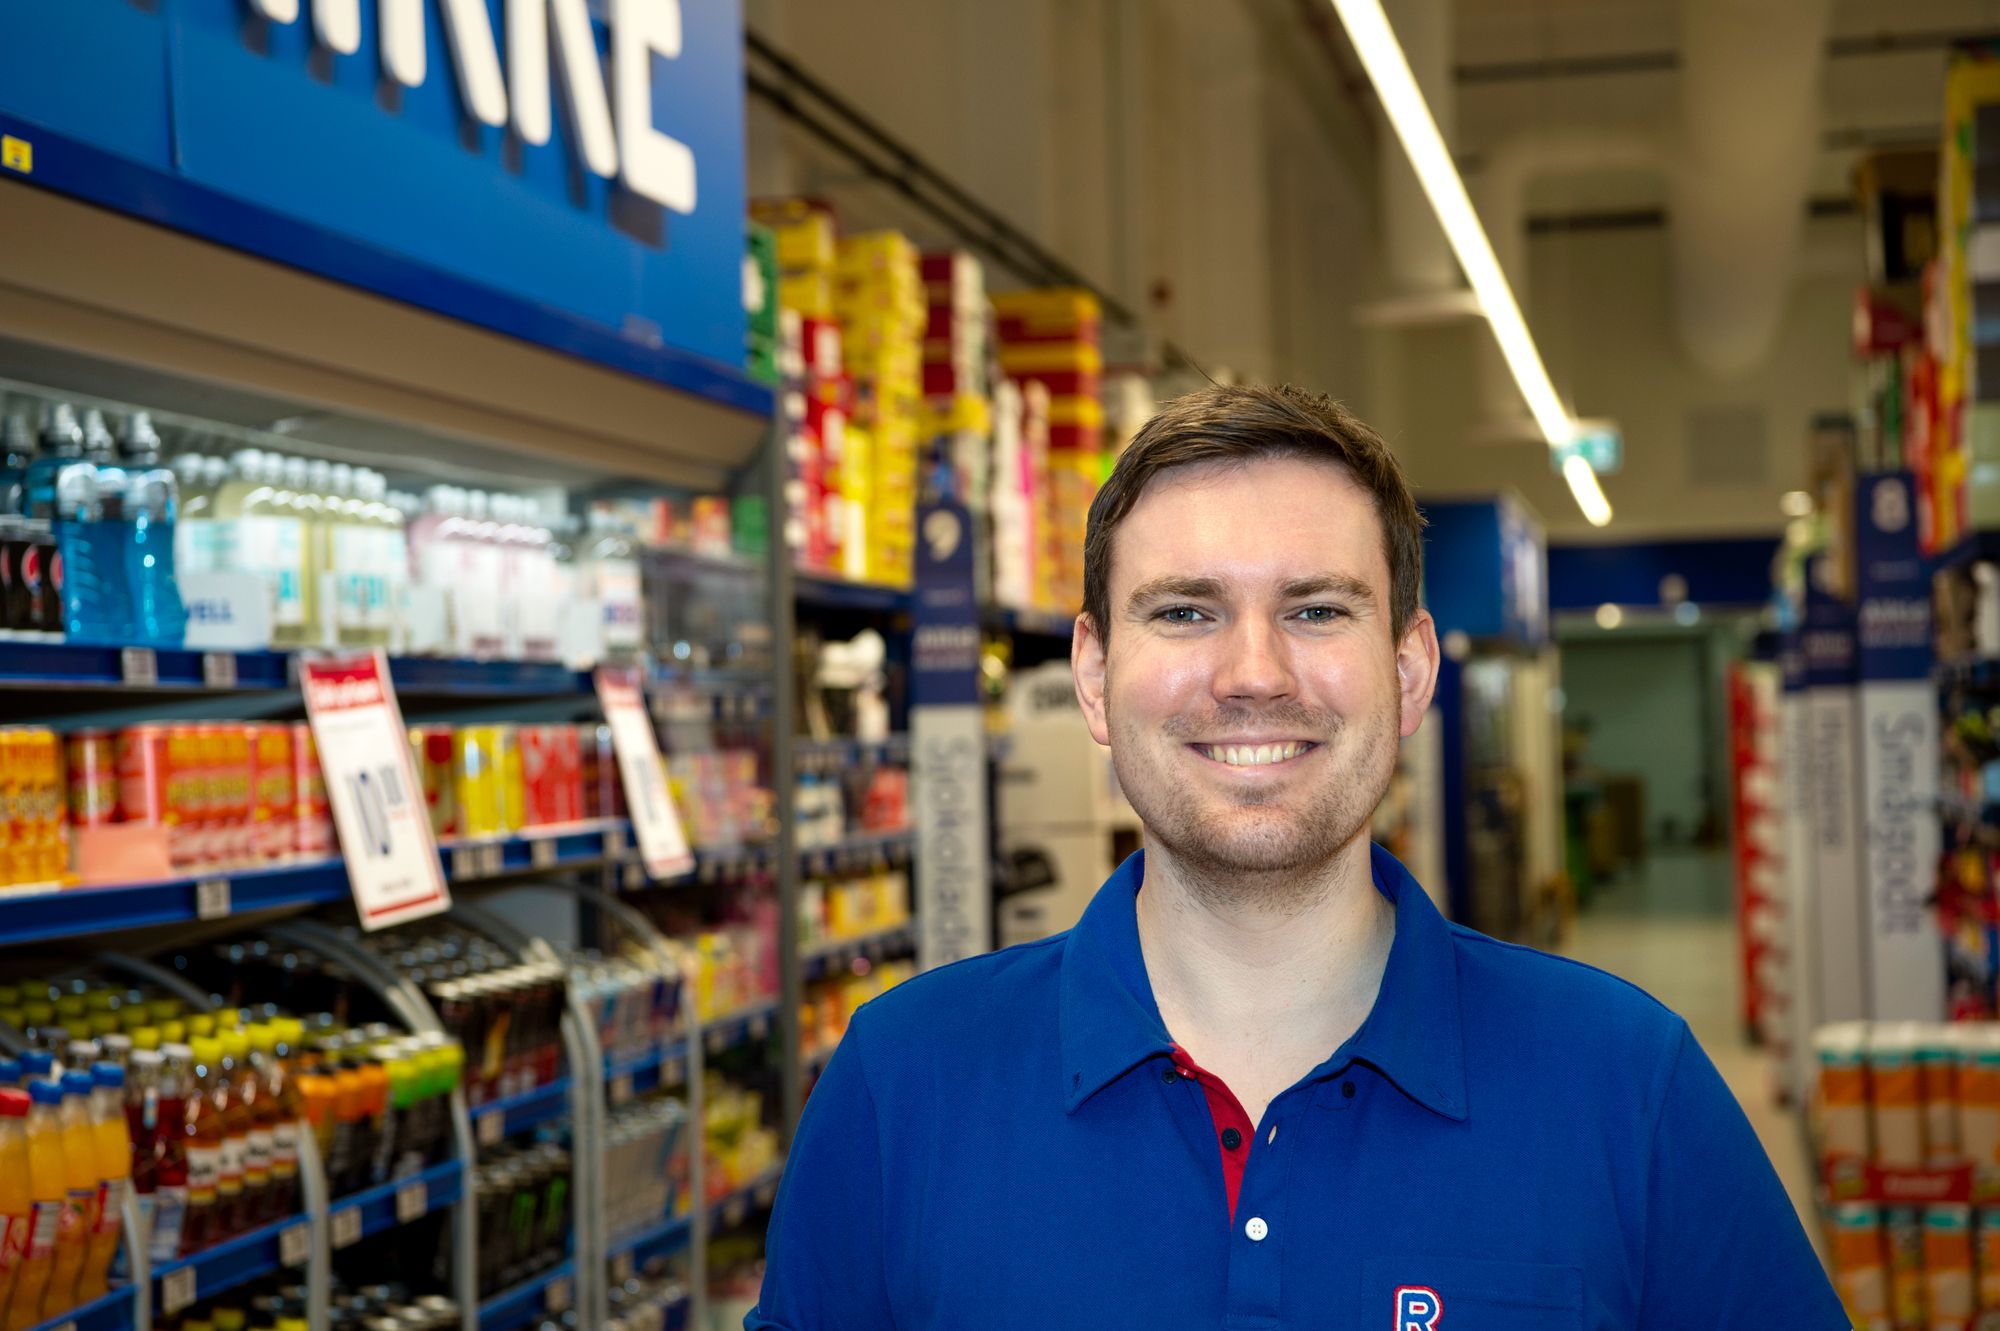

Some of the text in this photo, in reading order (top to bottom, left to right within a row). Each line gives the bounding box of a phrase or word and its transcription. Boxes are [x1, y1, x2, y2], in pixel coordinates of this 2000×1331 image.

[1870, 477, 1909, 533] 8
[922, 509, 962, 562] 9
[1393, 1284, 1445, 1331] R
